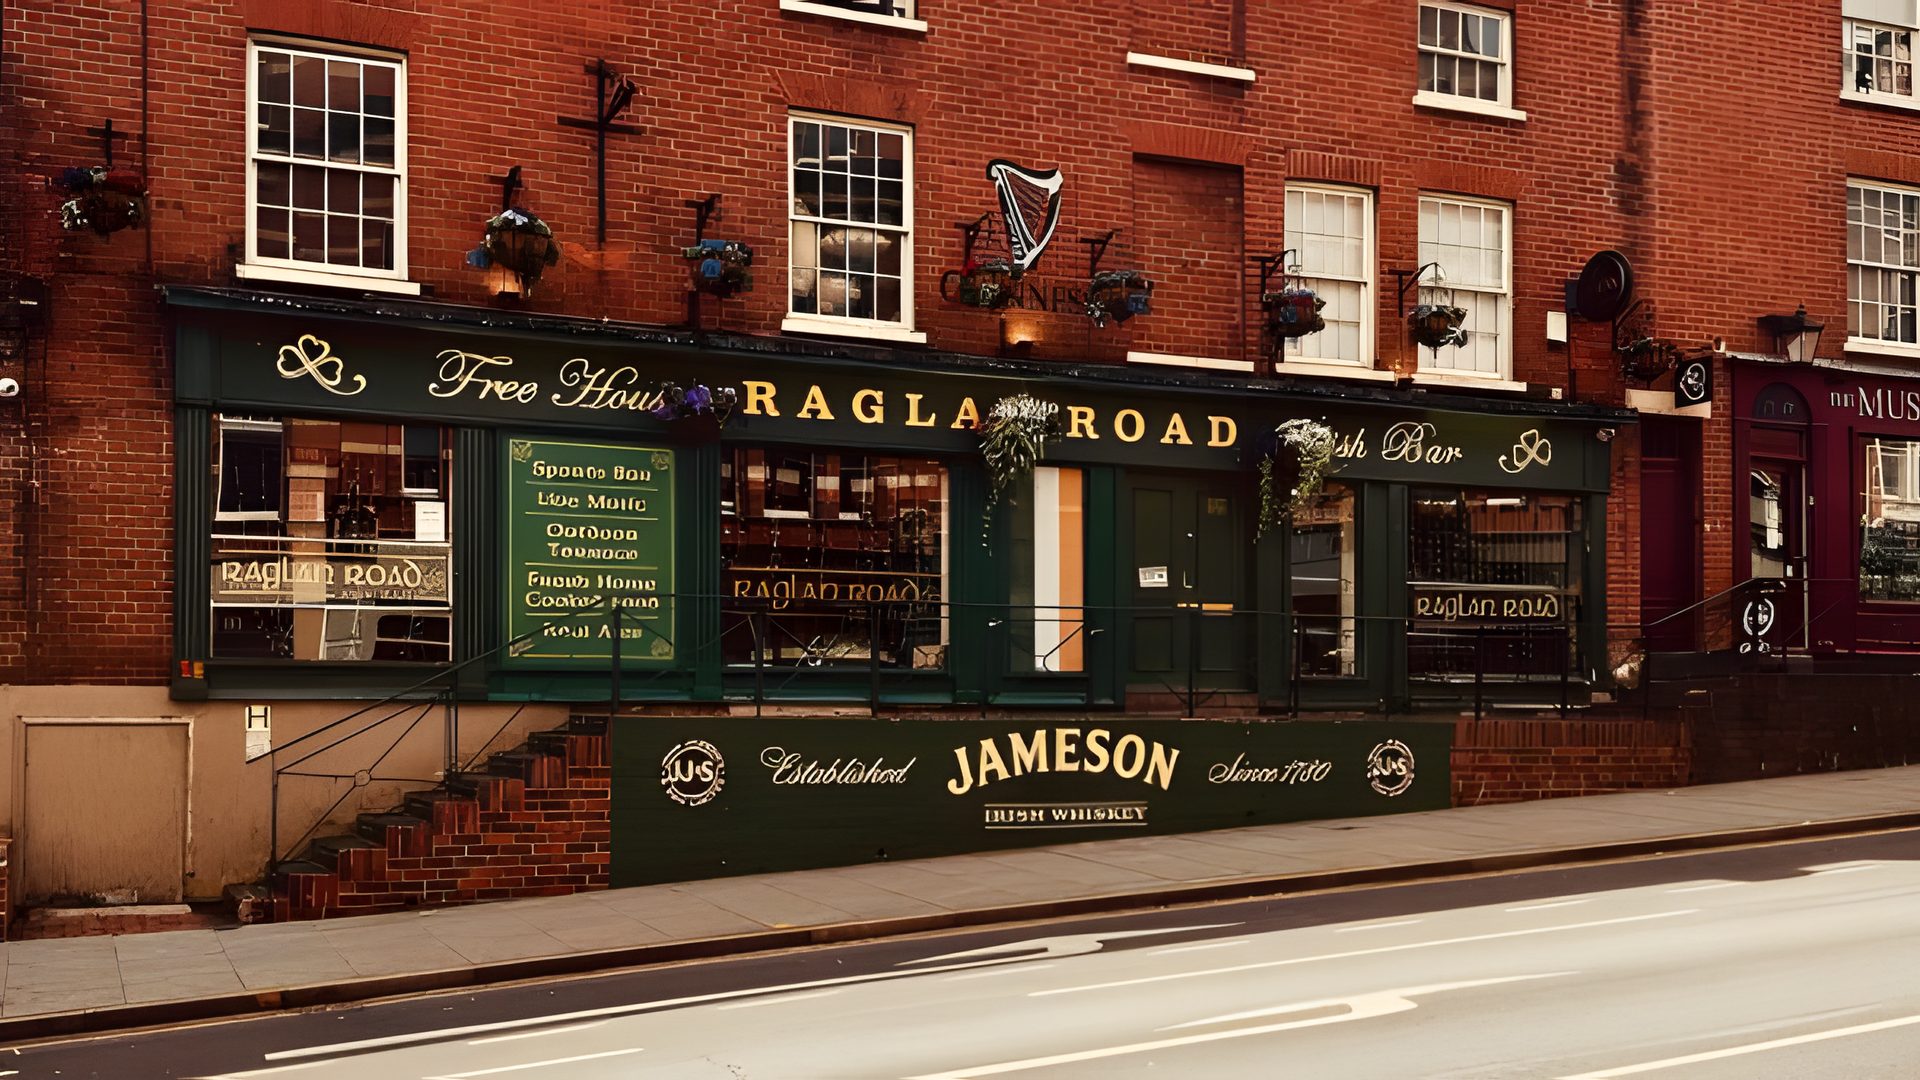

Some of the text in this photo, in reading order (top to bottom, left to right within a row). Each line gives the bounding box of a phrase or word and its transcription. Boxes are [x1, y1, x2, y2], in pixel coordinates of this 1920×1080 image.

[551, 358, 666, 412] Hous
[743, 380, 1239, 449] RAGLA ROAD
[1381, 421, 1463, 463] Bar
[247, 706, 269, 729] H
[946, 728, 1181, 796] JAMESON
